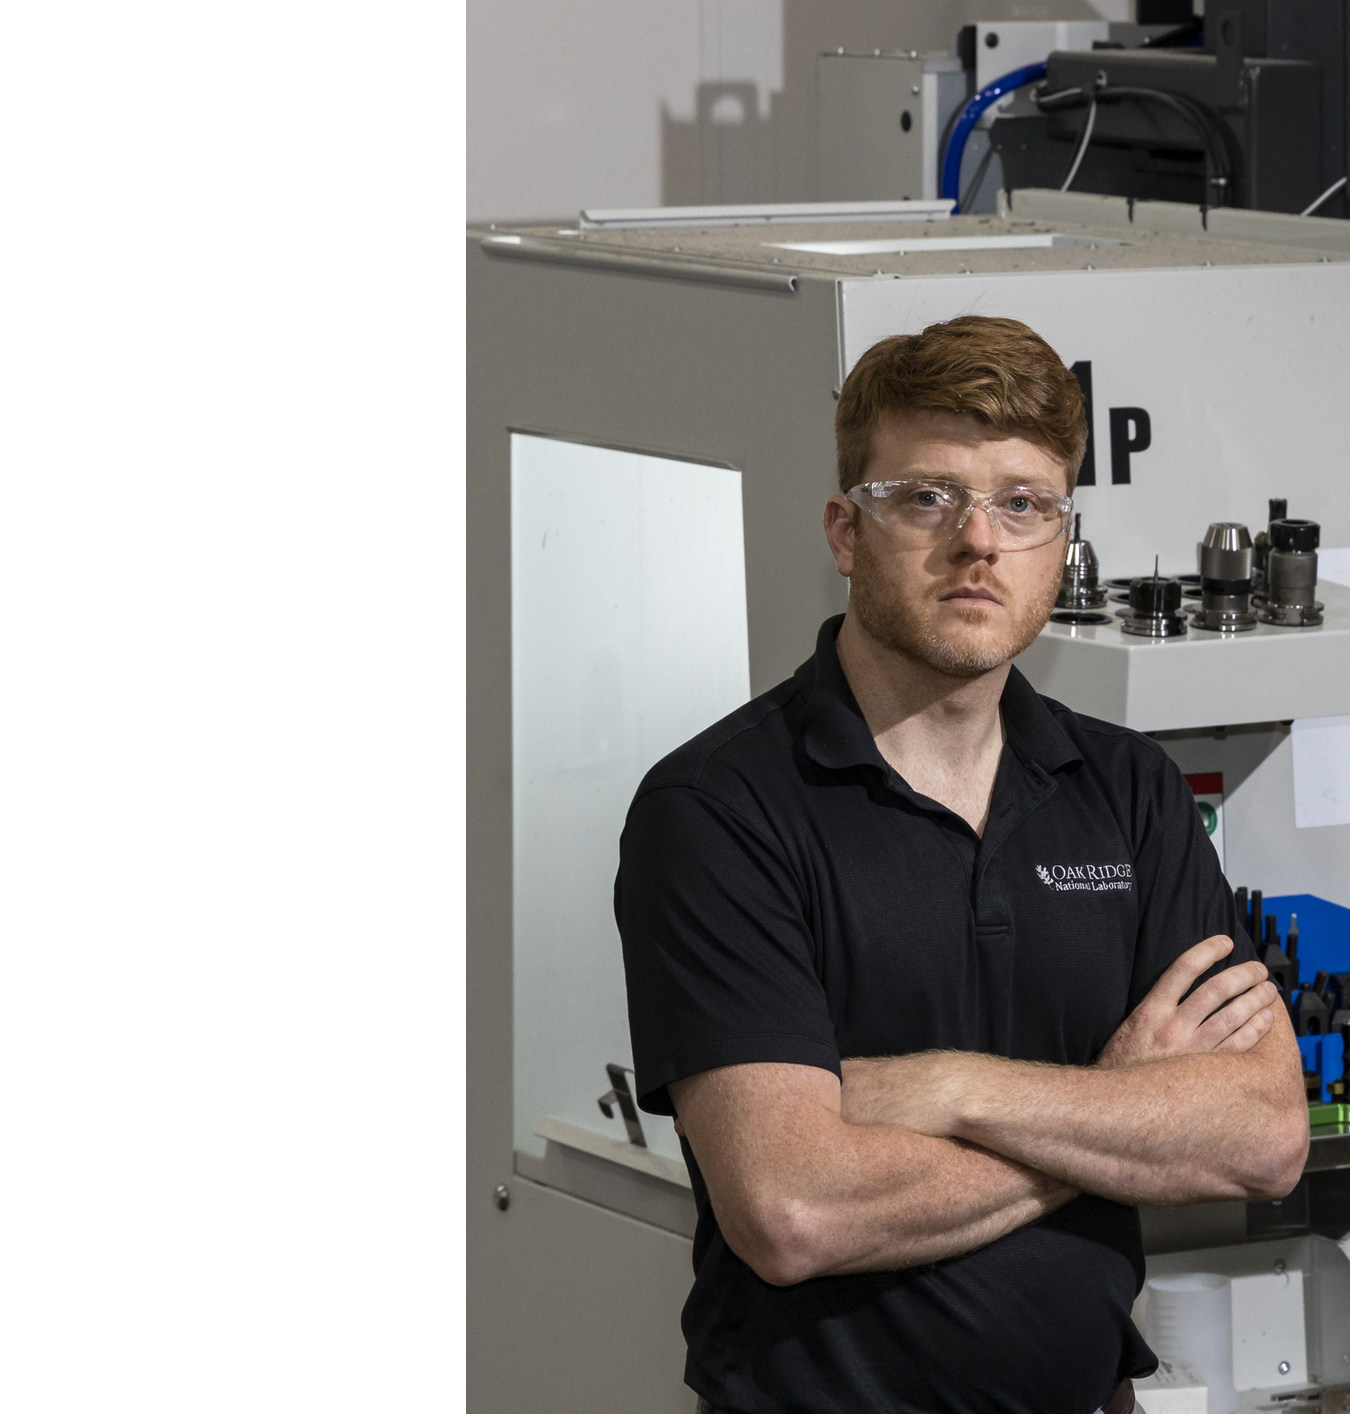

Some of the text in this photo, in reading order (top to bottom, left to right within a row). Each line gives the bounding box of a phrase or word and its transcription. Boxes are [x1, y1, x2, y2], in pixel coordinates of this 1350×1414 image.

[1086, 864, 1132, 879] RIDGE
[1055, 880, 1132, 891] National Laboratory
